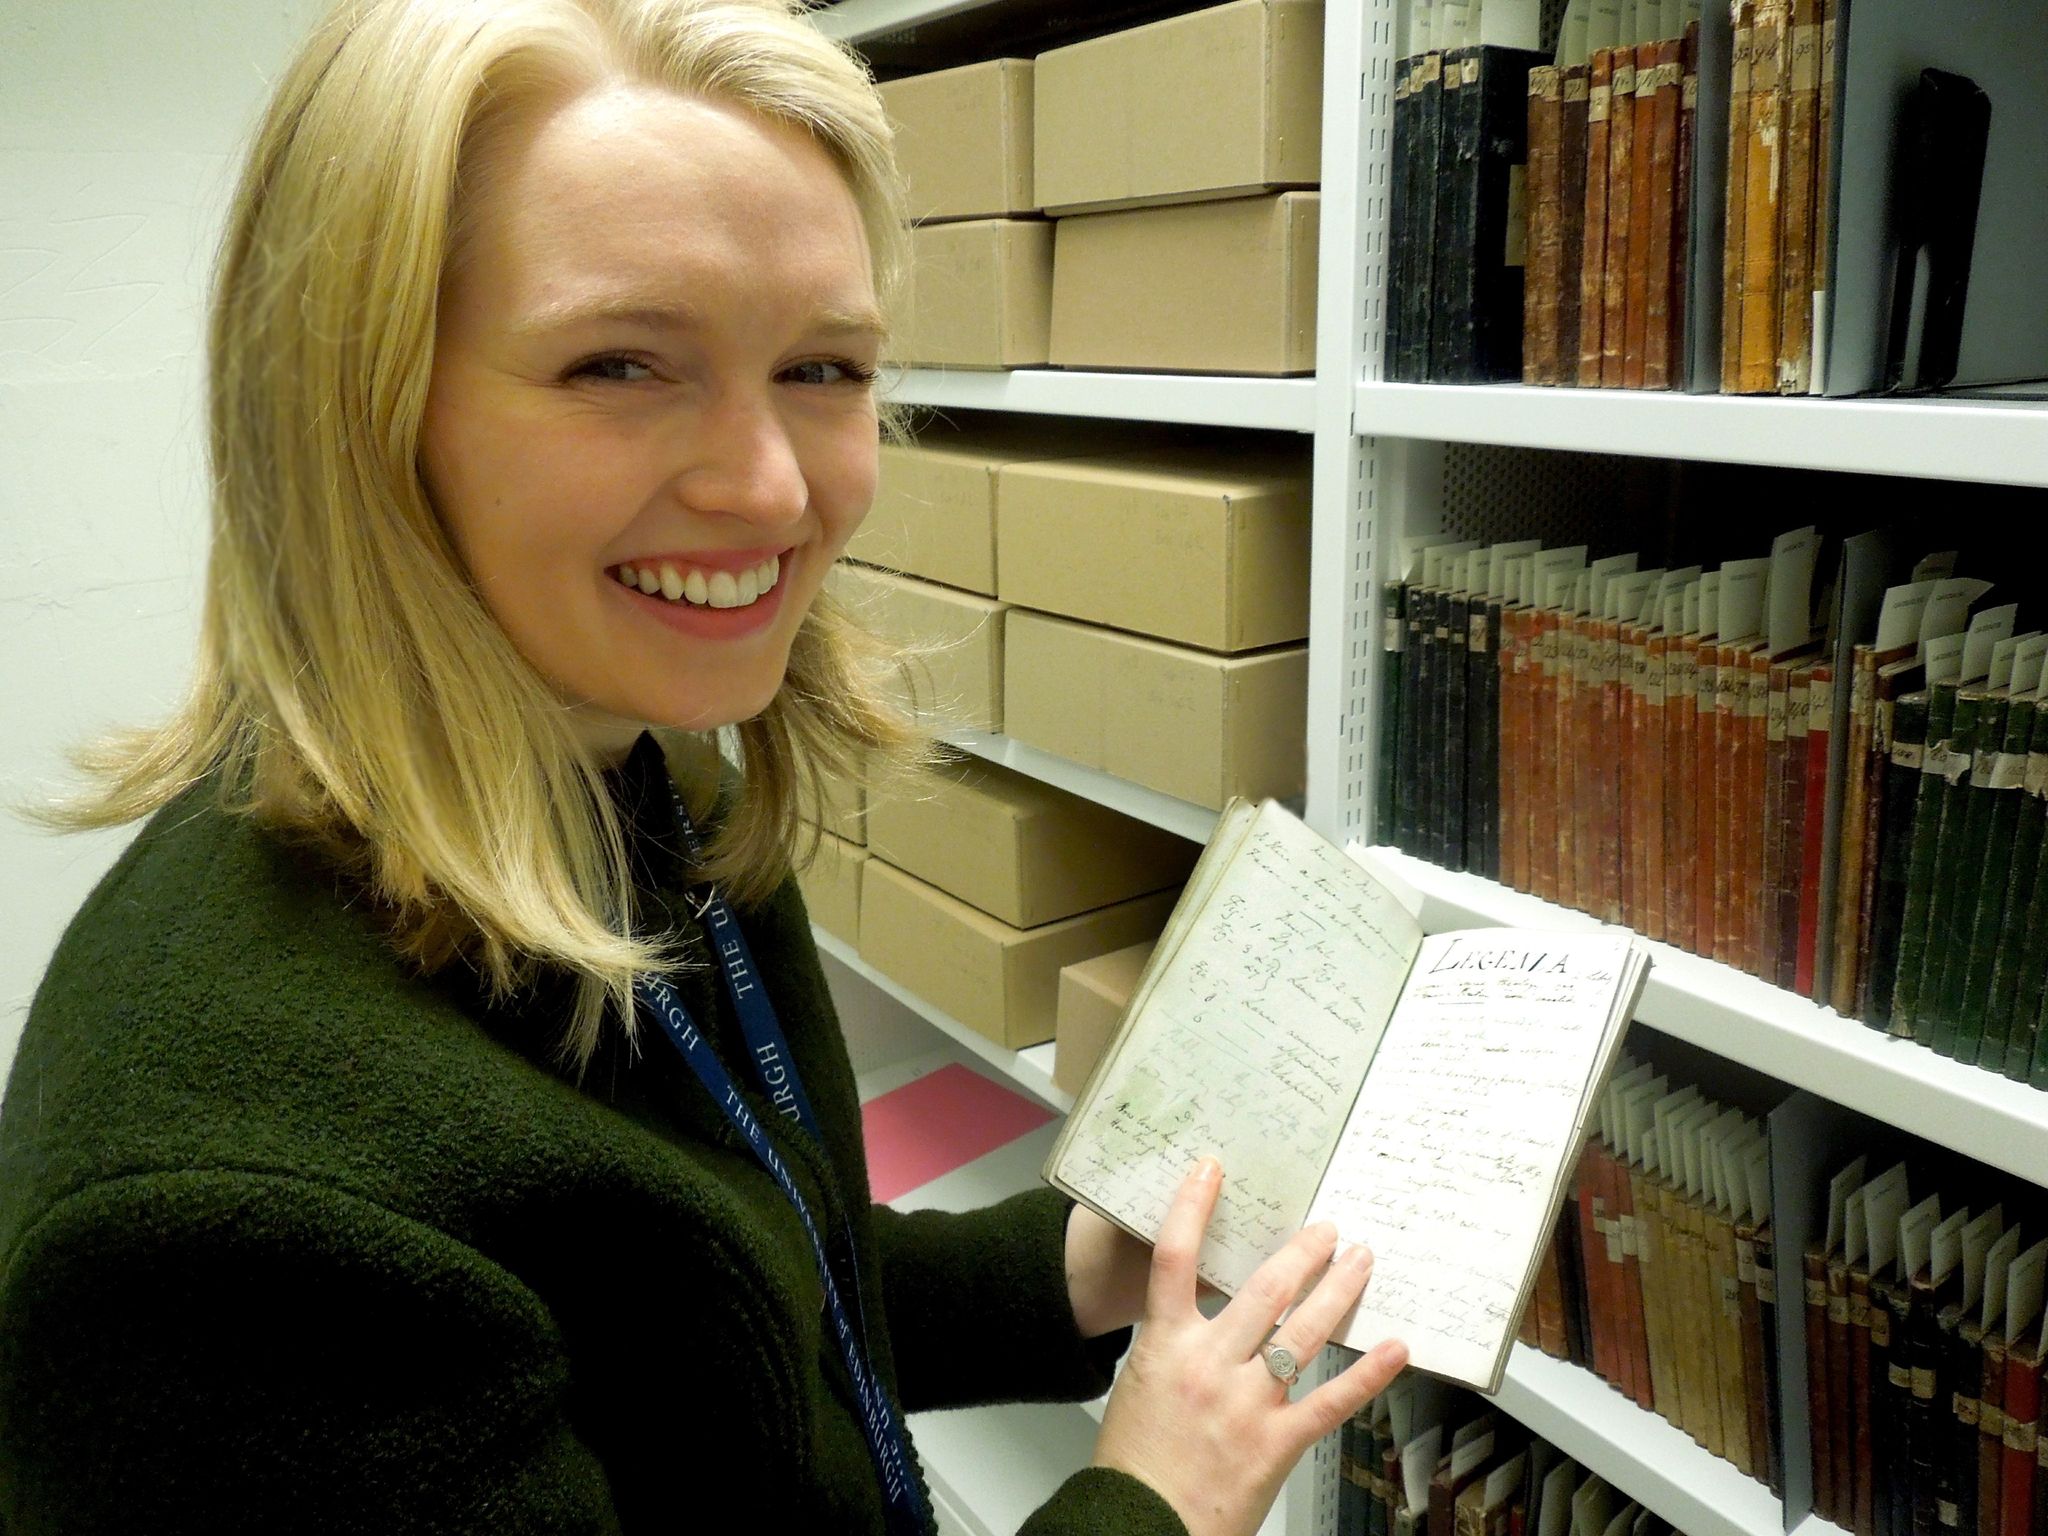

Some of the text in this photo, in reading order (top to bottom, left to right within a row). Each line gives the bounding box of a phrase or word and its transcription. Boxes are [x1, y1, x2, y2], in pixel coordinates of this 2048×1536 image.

[722, 938, 754, 1000] THE
[726, 1085, 761, 1145] THE
[767, 1148, 839, 1309] UNIVERSITY
[838, 1317, 849, 1339] of
[848, 1340, 902, 1504] EDINBURGH
